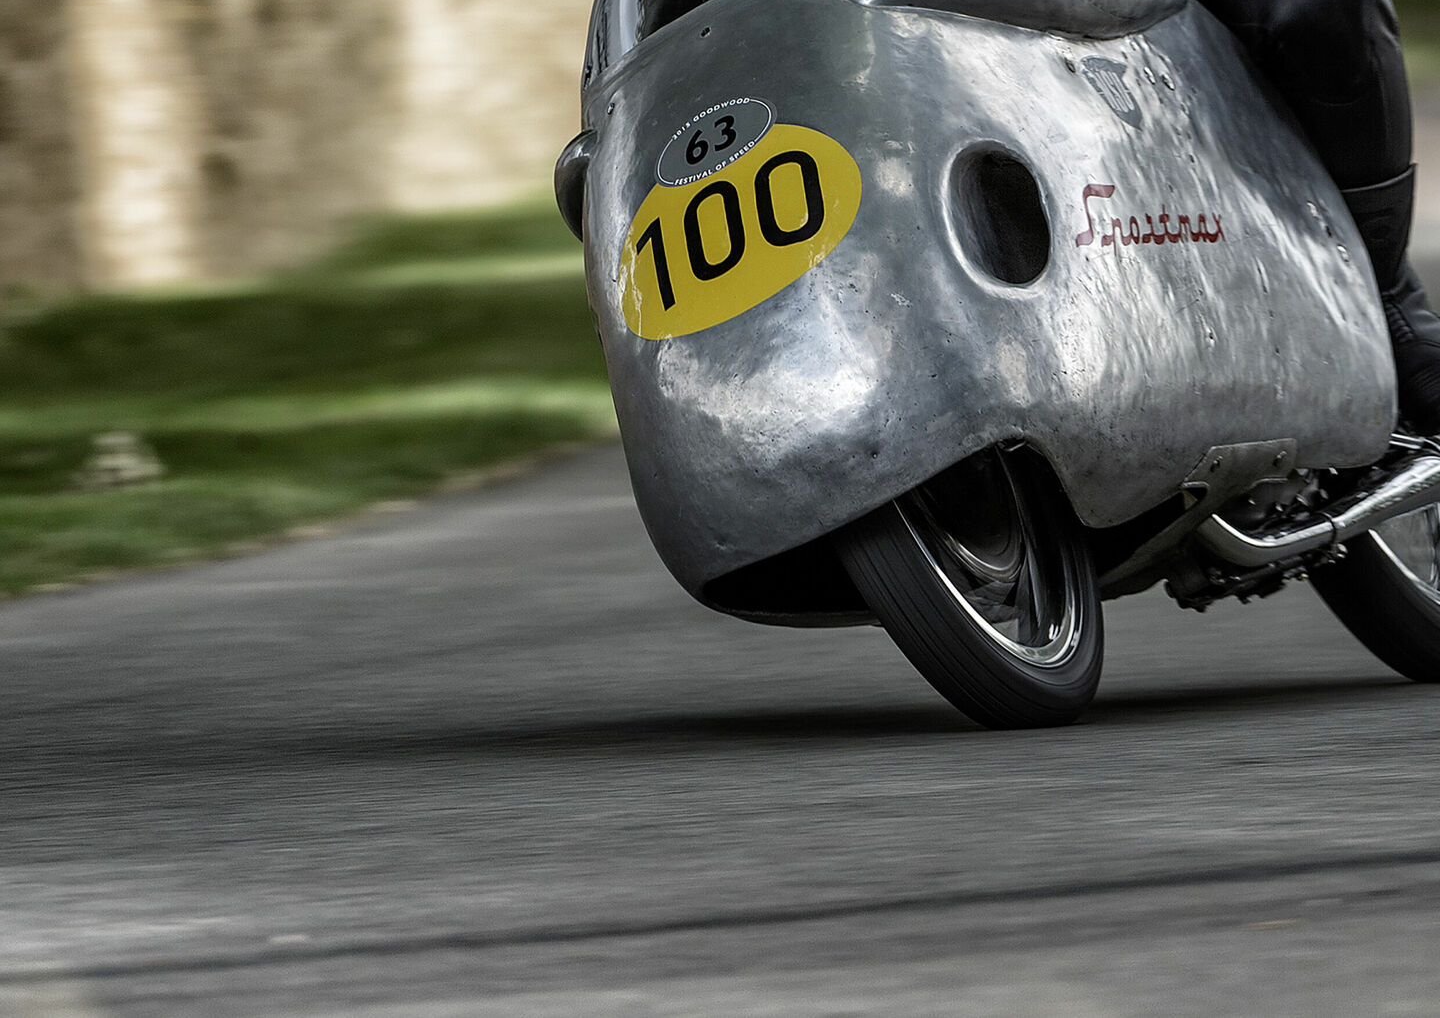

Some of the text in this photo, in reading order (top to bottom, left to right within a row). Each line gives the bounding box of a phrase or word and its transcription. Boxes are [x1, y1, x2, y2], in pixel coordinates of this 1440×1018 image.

[692, 97, 751, 123] GOODWOOD
[673, 140, 756, 186] FESTIVAL OF SPEED
[686, 115, 737, 165] 63
[635, 150, 825, 312] 100
